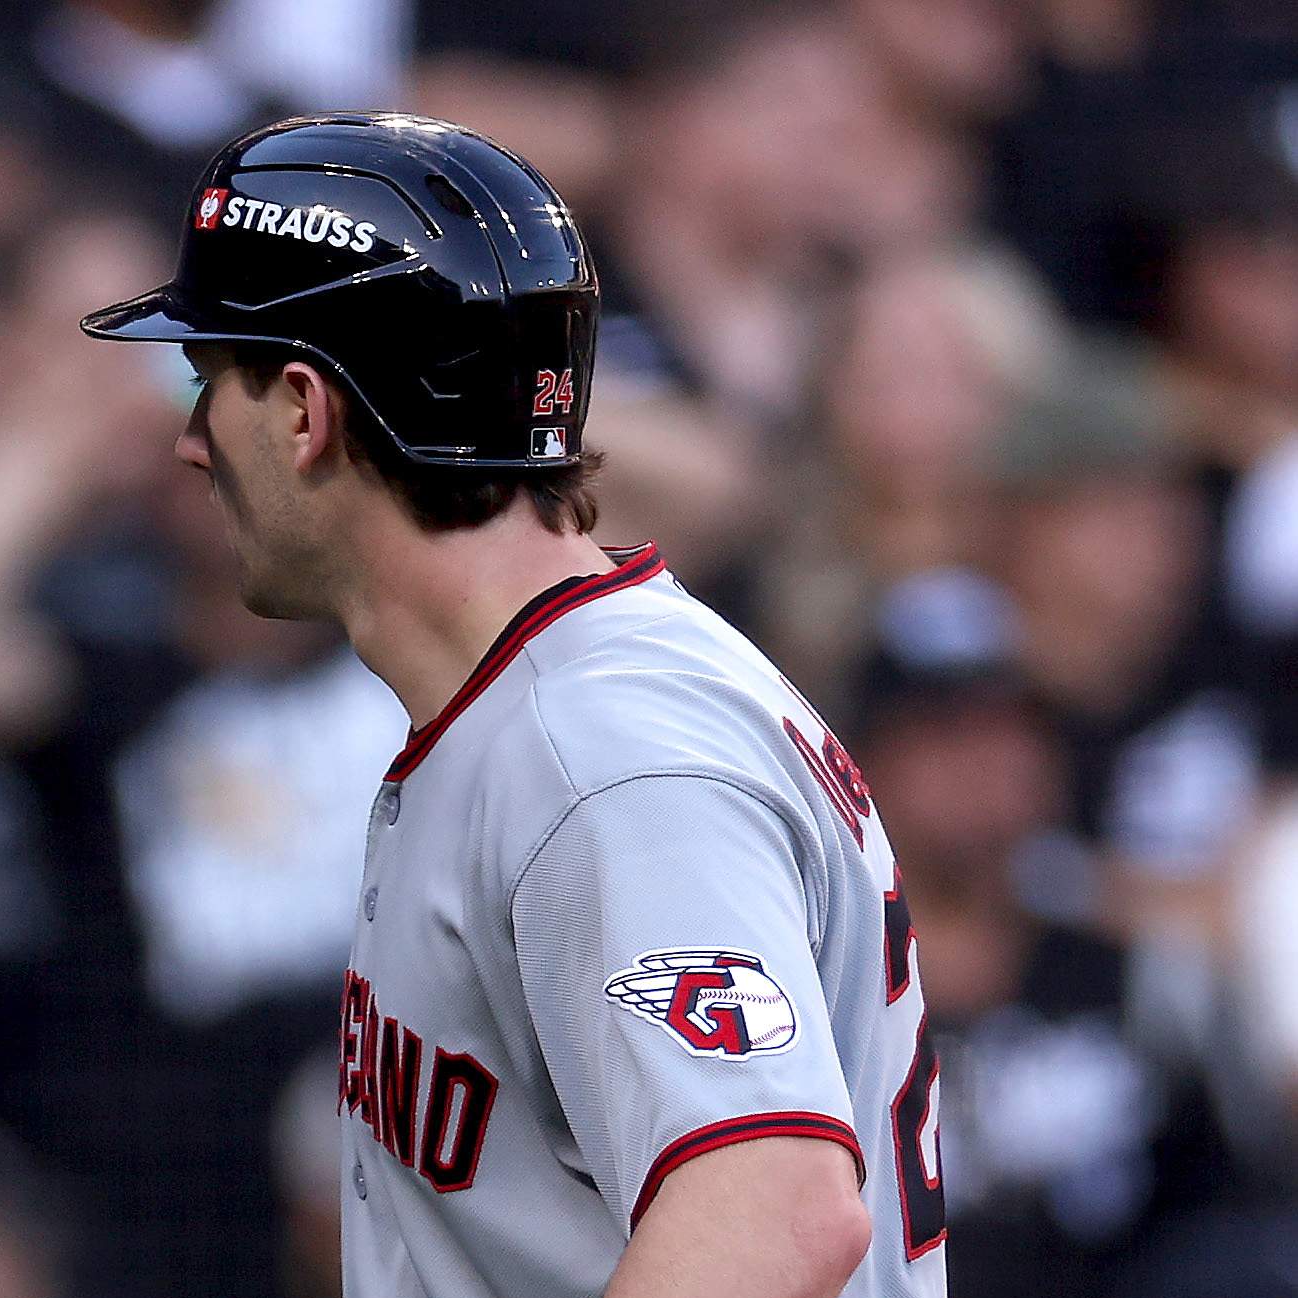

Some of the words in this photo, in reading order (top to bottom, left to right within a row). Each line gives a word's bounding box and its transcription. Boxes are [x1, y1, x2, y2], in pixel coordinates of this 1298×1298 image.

[222, 196, 377, 254] STRAUSS
[533, 369, 574, 416] 24
[665, 967, 750, 1057] G
